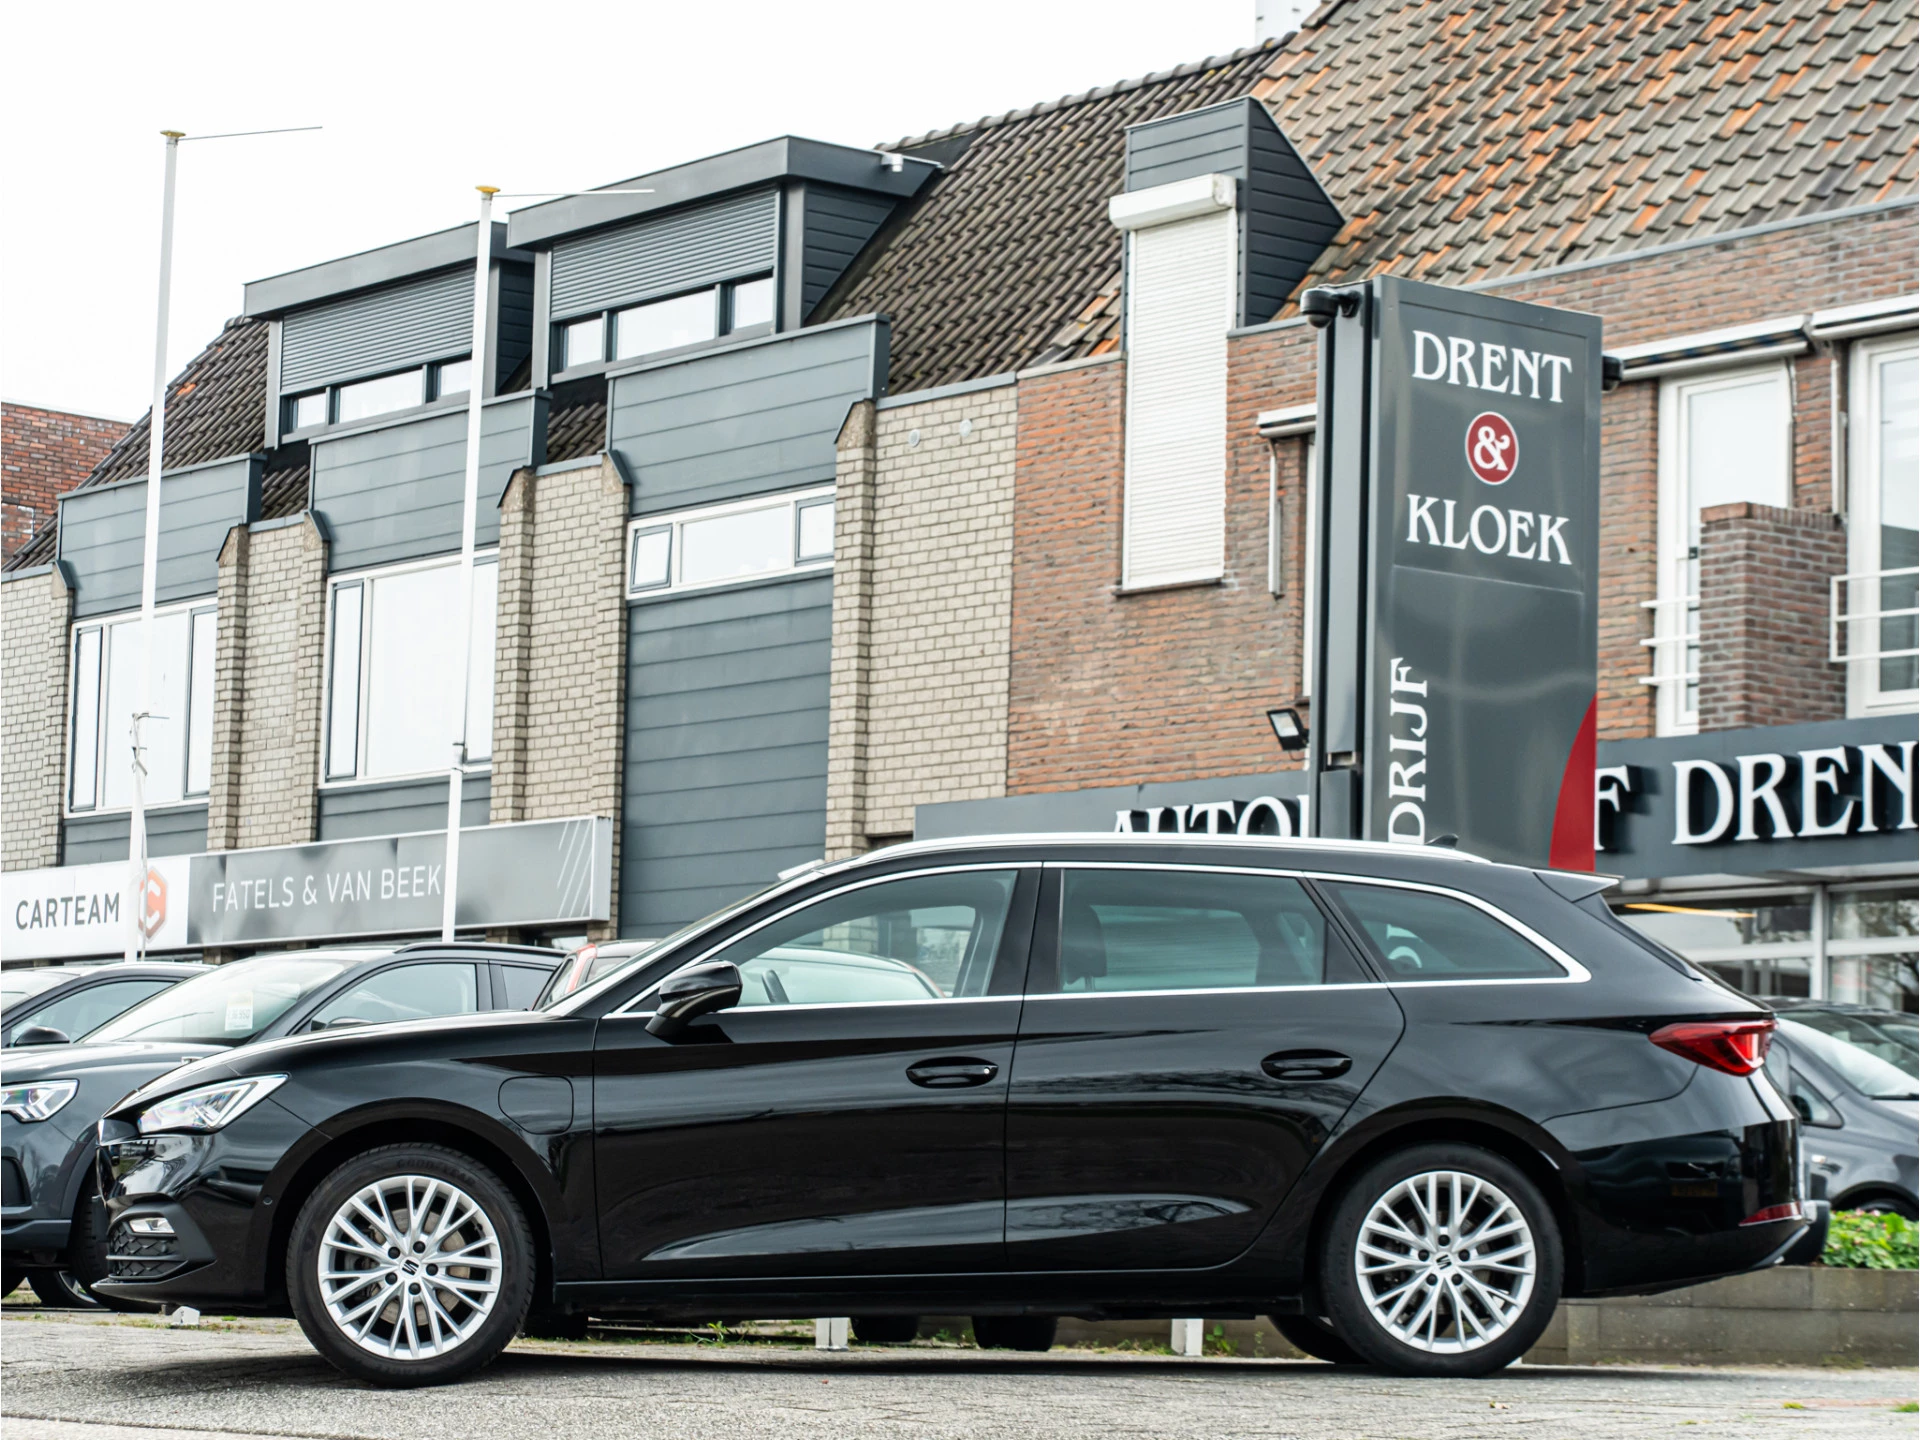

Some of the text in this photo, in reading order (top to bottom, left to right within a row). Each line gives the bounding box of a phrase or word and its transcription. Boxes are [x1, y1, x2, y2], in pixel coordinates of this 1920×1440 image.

[1411, 329, 1573, 403] DRENT
[1473, 425, 1511, 472] &
[1406, 493, 1573, 566] KLOEK
[15, 892, 120, 931] CARTEAM
[212, 864, 442, 912] FATELS & VAN BEEK
